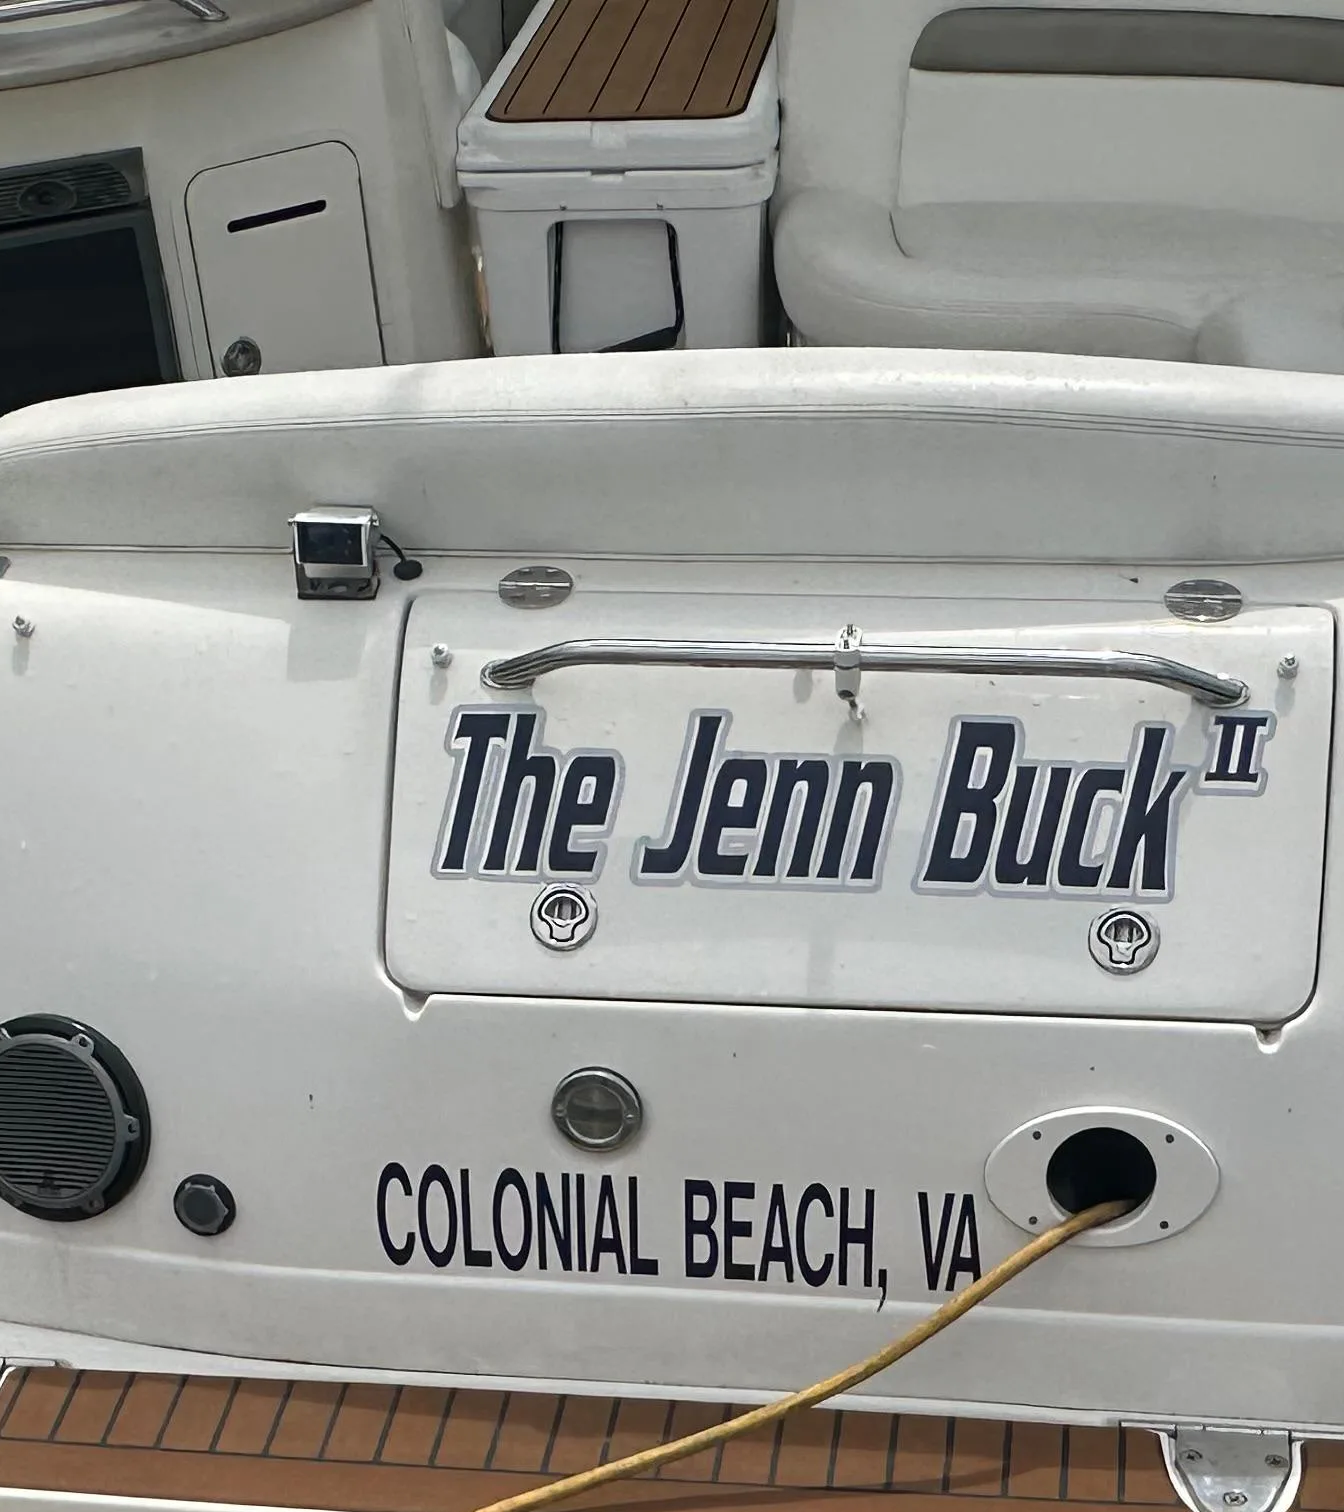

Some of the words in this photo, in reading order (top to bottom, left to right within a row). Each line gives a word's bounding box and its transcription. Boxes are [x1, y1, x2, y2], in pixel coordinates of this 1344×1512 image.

[438, 709, 620, 878] The
[638, 712, 895, 883] Jenn
[924, 717, 1188, 893] Buck
[1203, 715, 1268, 783] II
[376, 1162, 659, 1276] COLONIAL
[684, 1178, 888, 1313] BEACH,
[917, 1191, 983, 1292] VA
